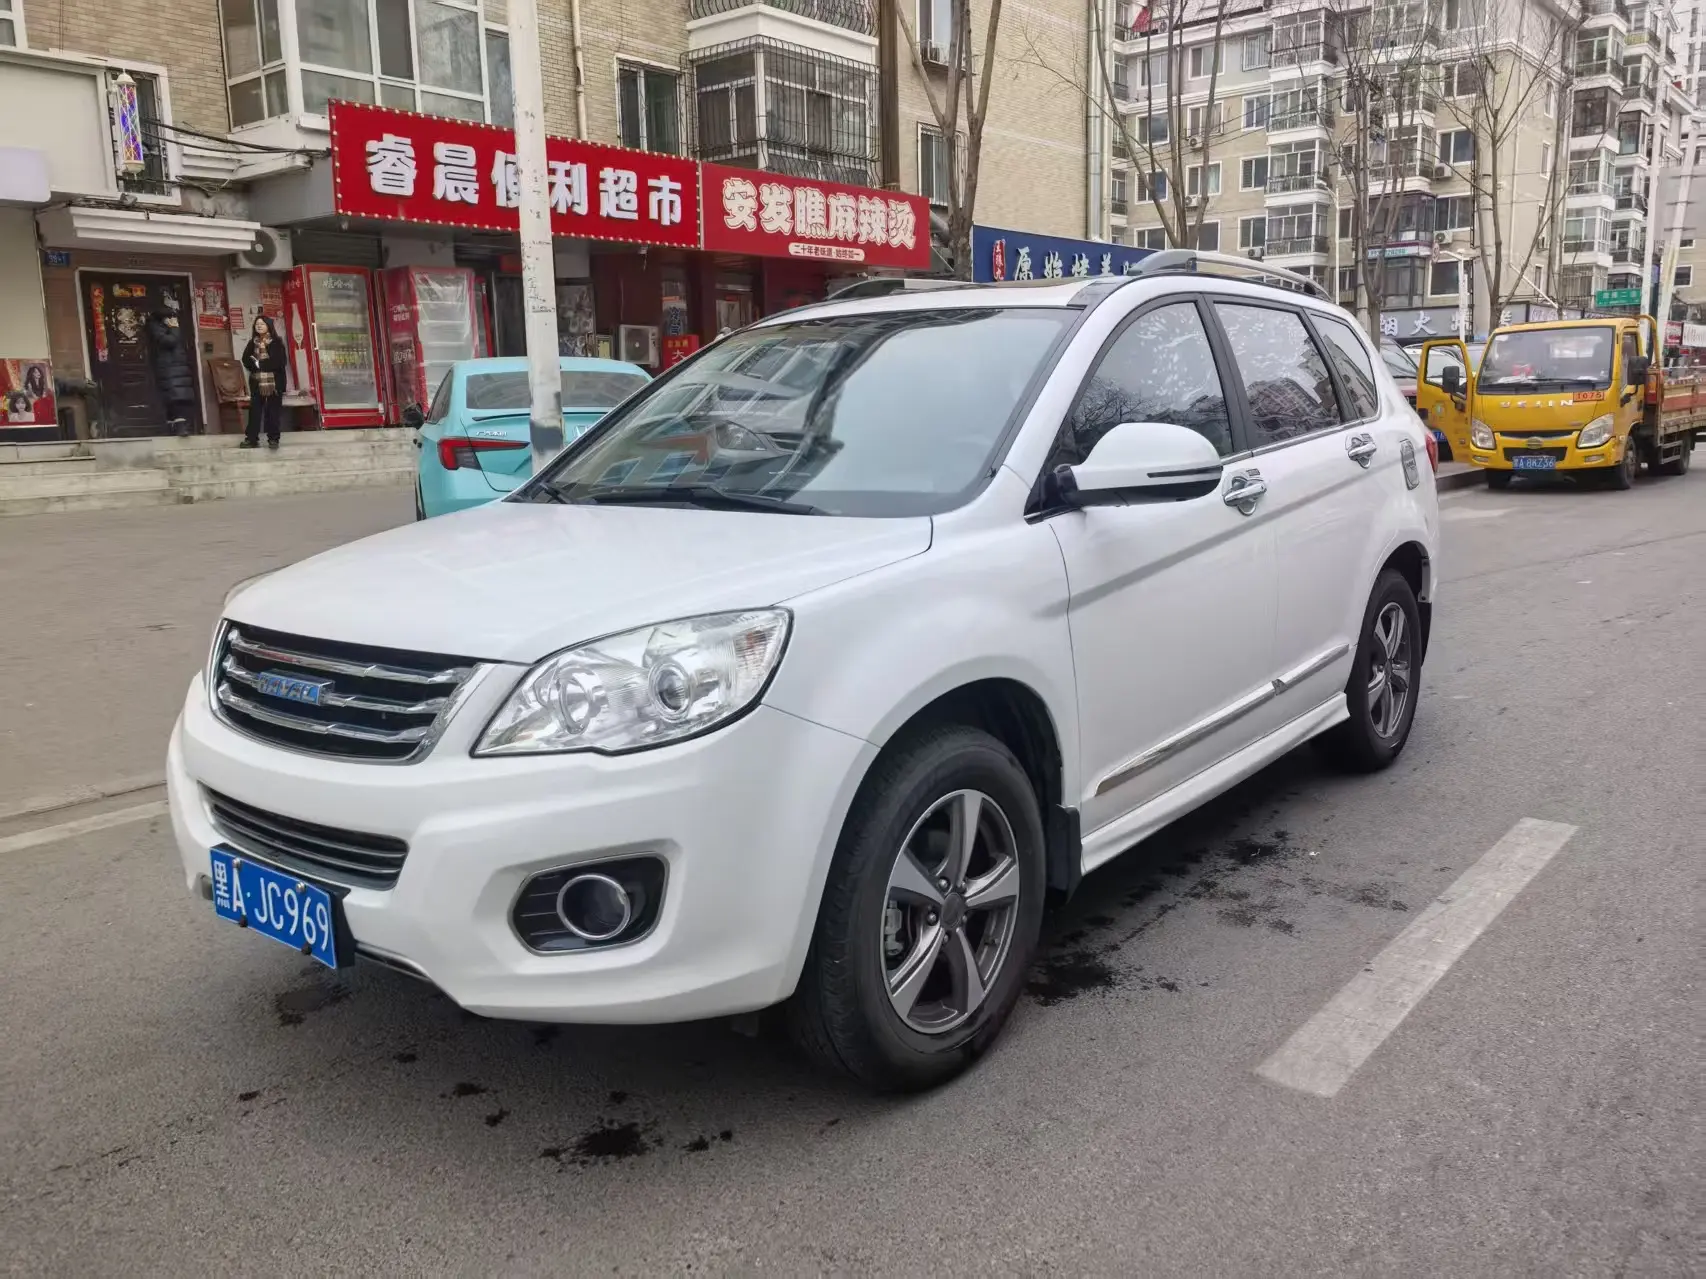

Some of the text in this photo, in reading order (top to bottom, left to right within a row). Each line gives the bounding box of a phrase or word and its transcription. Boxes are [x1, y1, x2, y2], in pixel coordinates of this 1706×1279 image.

[722, 177, 916, 249] 安发瞧麻辣烫
[213, 860, 330, 951] 黑A·JC969
